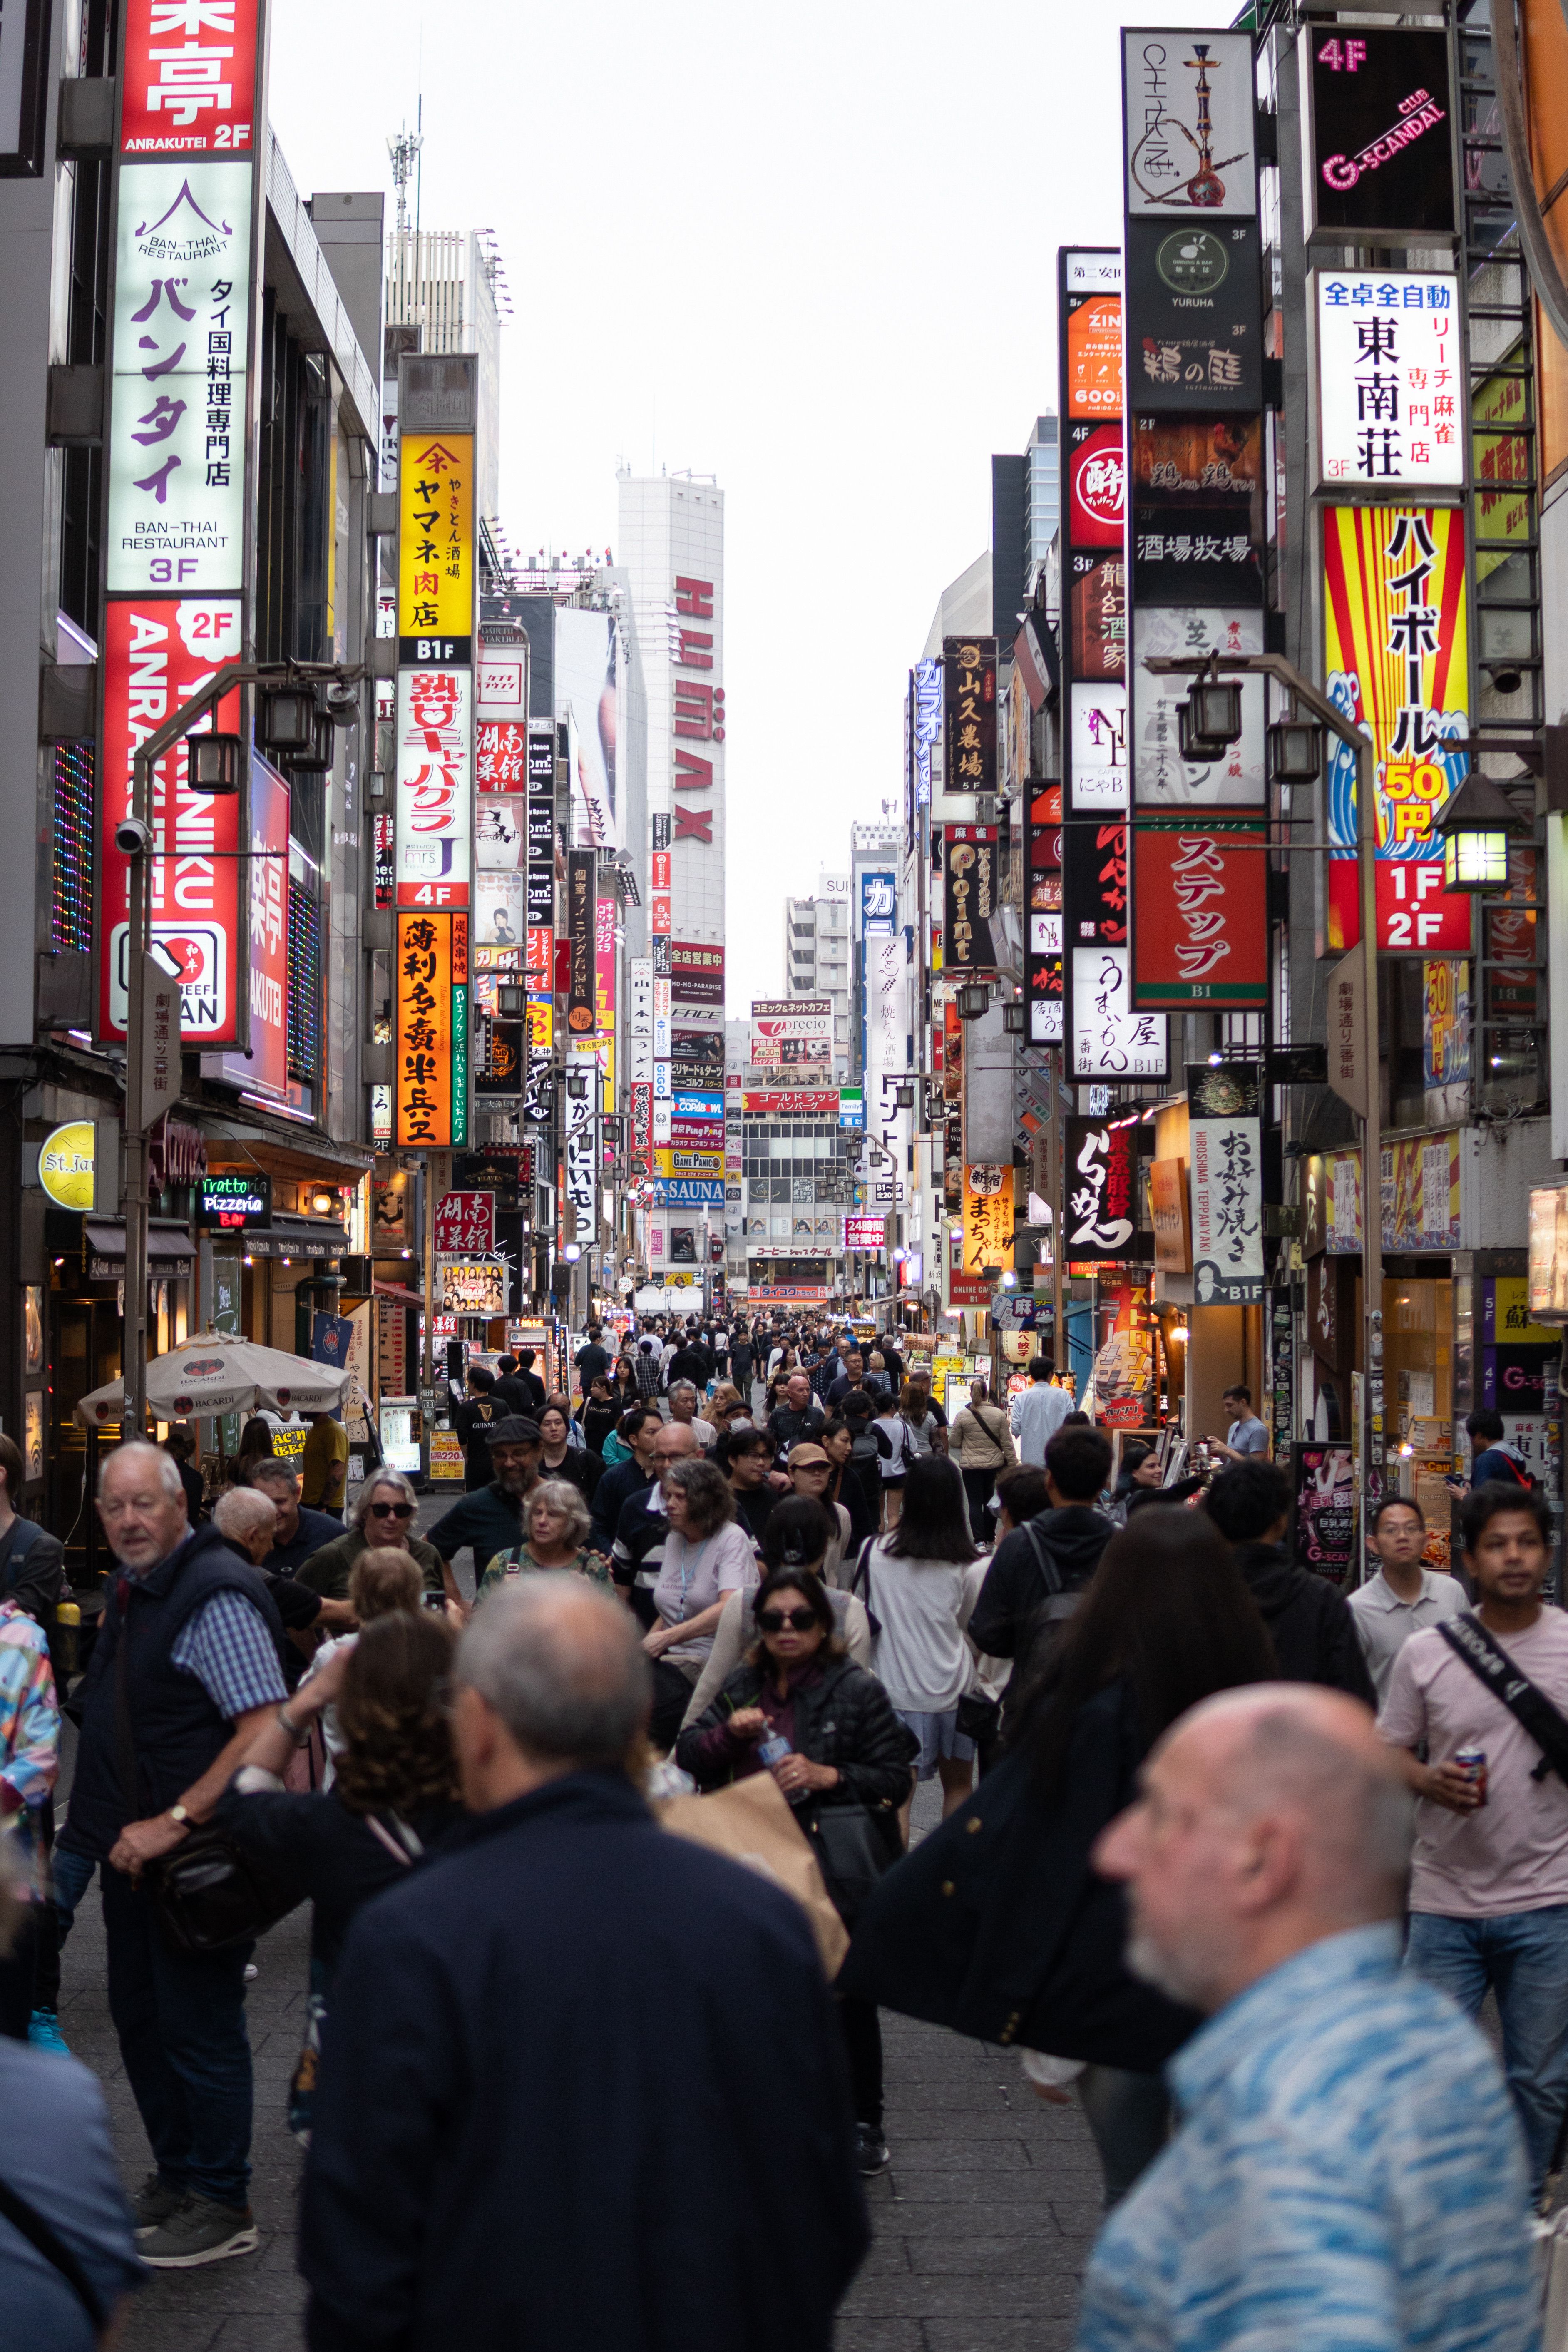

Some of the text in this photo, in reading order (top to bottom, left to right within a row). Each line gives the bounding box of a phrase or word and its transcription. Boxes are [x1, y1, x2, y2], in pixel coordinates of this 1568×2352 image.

[1318, 38, 1367, 72] 4F
[1397, 88, 1430, 115] CLUB
[125, 137, 206, 150] ANRAKUTEI
[214, 125, 250, 148] 2F
[1322, 103, 1446, 191] G-SCANDAL
[150, 234, 217, 249] BAN-THAI
[1232, 229, 1247, 240] 3F
[138, 240, 228, 261] RESTAURANT
[1070, 298, 1082, 307] 5F
[1172, 298, 1214, 308] YURUHA
[1324, 282, 1451, 309] 全卓全自動
[1232, 326, 1246, 336] 3F
[1143, 345, 1245, 385] 鶏の庭
[130, 278, 197, 504] バンタイ
[206, 278, 233, 487] タイ国料理専門店
[1433, 317, 1455, 445] リーチ麻雀
[1075, 389, 1116, 403] 600
[1353, 316, 1403, 478] 東南荘
[1140, 419, 1155, 430] 2F
[1407, 368, 1430, 464] 専門店
[1072, 427, 1089, 441] 4F
[1328, 459, 1350, 477] 3F
[135, 521, 217, 533] BAN-THAI
[445, 478, 461, 580] やきとん酒場
[122, 537, 229, 549] RESTAURANT
[409, 480, 440, 628] ヤマネ肉店
[1137, 535, 1252, 562] 酒場牧場
[149, 558, 199, 582] 3F
[1073, 556, 1093, 572] 3F
[192, 612, 233, 638] 2F
[1382, 515, 1442, 758] ハイボール
[417, 640, 454, 659] B1F
[957, 671, 984, 776] 山久農場
[477, 724, 523, 754] 湖南
[403, 673, 467, 834] 熟女キャバクラ
[477, 754, 523, 782] 菜館
[490, 782, 508, 791] 4F
[962, 782, 981, 790] 5F
[1384, 763, 1444, 801] 50
[954, 827, 987, 839] 麻雀
[1394, 802, 1433, 843] 円
[420, 837, 464, 878] J
[977, 848, 991, 918] MAHJONG
[1033, 873, 1044, 882] 3F
[1390, 866, 1443, 900] 1F
[415, 884, 451, 905] 4F
[950, 843, 976, 961] Point
[1171, 836, 1231, 979] ステップ
[1387, 912, 1444, 946] 2F
[186, 943, 199, 973] 和牛
[453, 920, 467, 974] 炭火串焼
[671, 949, 723, 967] 全店営業中
[671, 981, 722, 990] MO-MO-PARADISE
[1191, 985, 1212, 998] B1
[671, 1008, 723, 1020] FACE
[753, 1003, 830, 1013] コミック&ネットカフェ
[1095, 955, 1128, 1072] うまいもん
[880, 1004, 897, 1068] 焼とん酒場
[1126, 1016, 1160, 1046] 屋
[1339, 981, 1355, 1079] 劇場通り一番街
[576, 1039, 612, 1052] 今すぐ見つかる
[1078, 1029, 1093, 1073] 一番街
[671, 1063, 723, 1077] ビリヤード&ダーツ
[1133, 1059, 1164, 1073] B1F
[656, 1064, 666, 1094] GiGO
[686, 1078, 703, 1087] ゴルフ
[777, 1102, 819, 1110] ハンバーグ
[671, 1124, 685, 1134] 東京
[844, 1117, 852, 1126] 酒
[674, 1151, 713, 1167] GAME PANIC
[203, 1178, 267, 1193] Trattoria
[669, 1181, 724, 1199] SAUNA
[1195, 1131, 1211, 1253] HIROSHIMA TEPPANYAKI
[1215, 1129, 1259, 1263] お好み焼き
[204, 1195, 264, 1211] Pizzeria
[436, 1194, 490, 1223] 湖南
[219, 1212, 246, 1227] Bar
[848, 1220, 885, 1232] 24時間
[447, 1224, 489, 1251] 菜館
[848, 1234, 884, 1245] 営業中
[969, 1196, 992, 1267] まっちゃん
[757, 1247, 832, 1256] コーヒー クール
[762, 1287, 796, 1297] ダイコク
[1230, 1285, 1262, 1300] B1F
[1099, 1299, 1121, 1390] ラーメン
[1127, 1288, 1147, 1391] ストロング
[350, 1364, 360, 1405] やきとん
[422, 1389, 434, 1397] NERO
[195, 1395, 234, 1408] BACARDÍ
[422, 1400, 435, 1409] NERO
